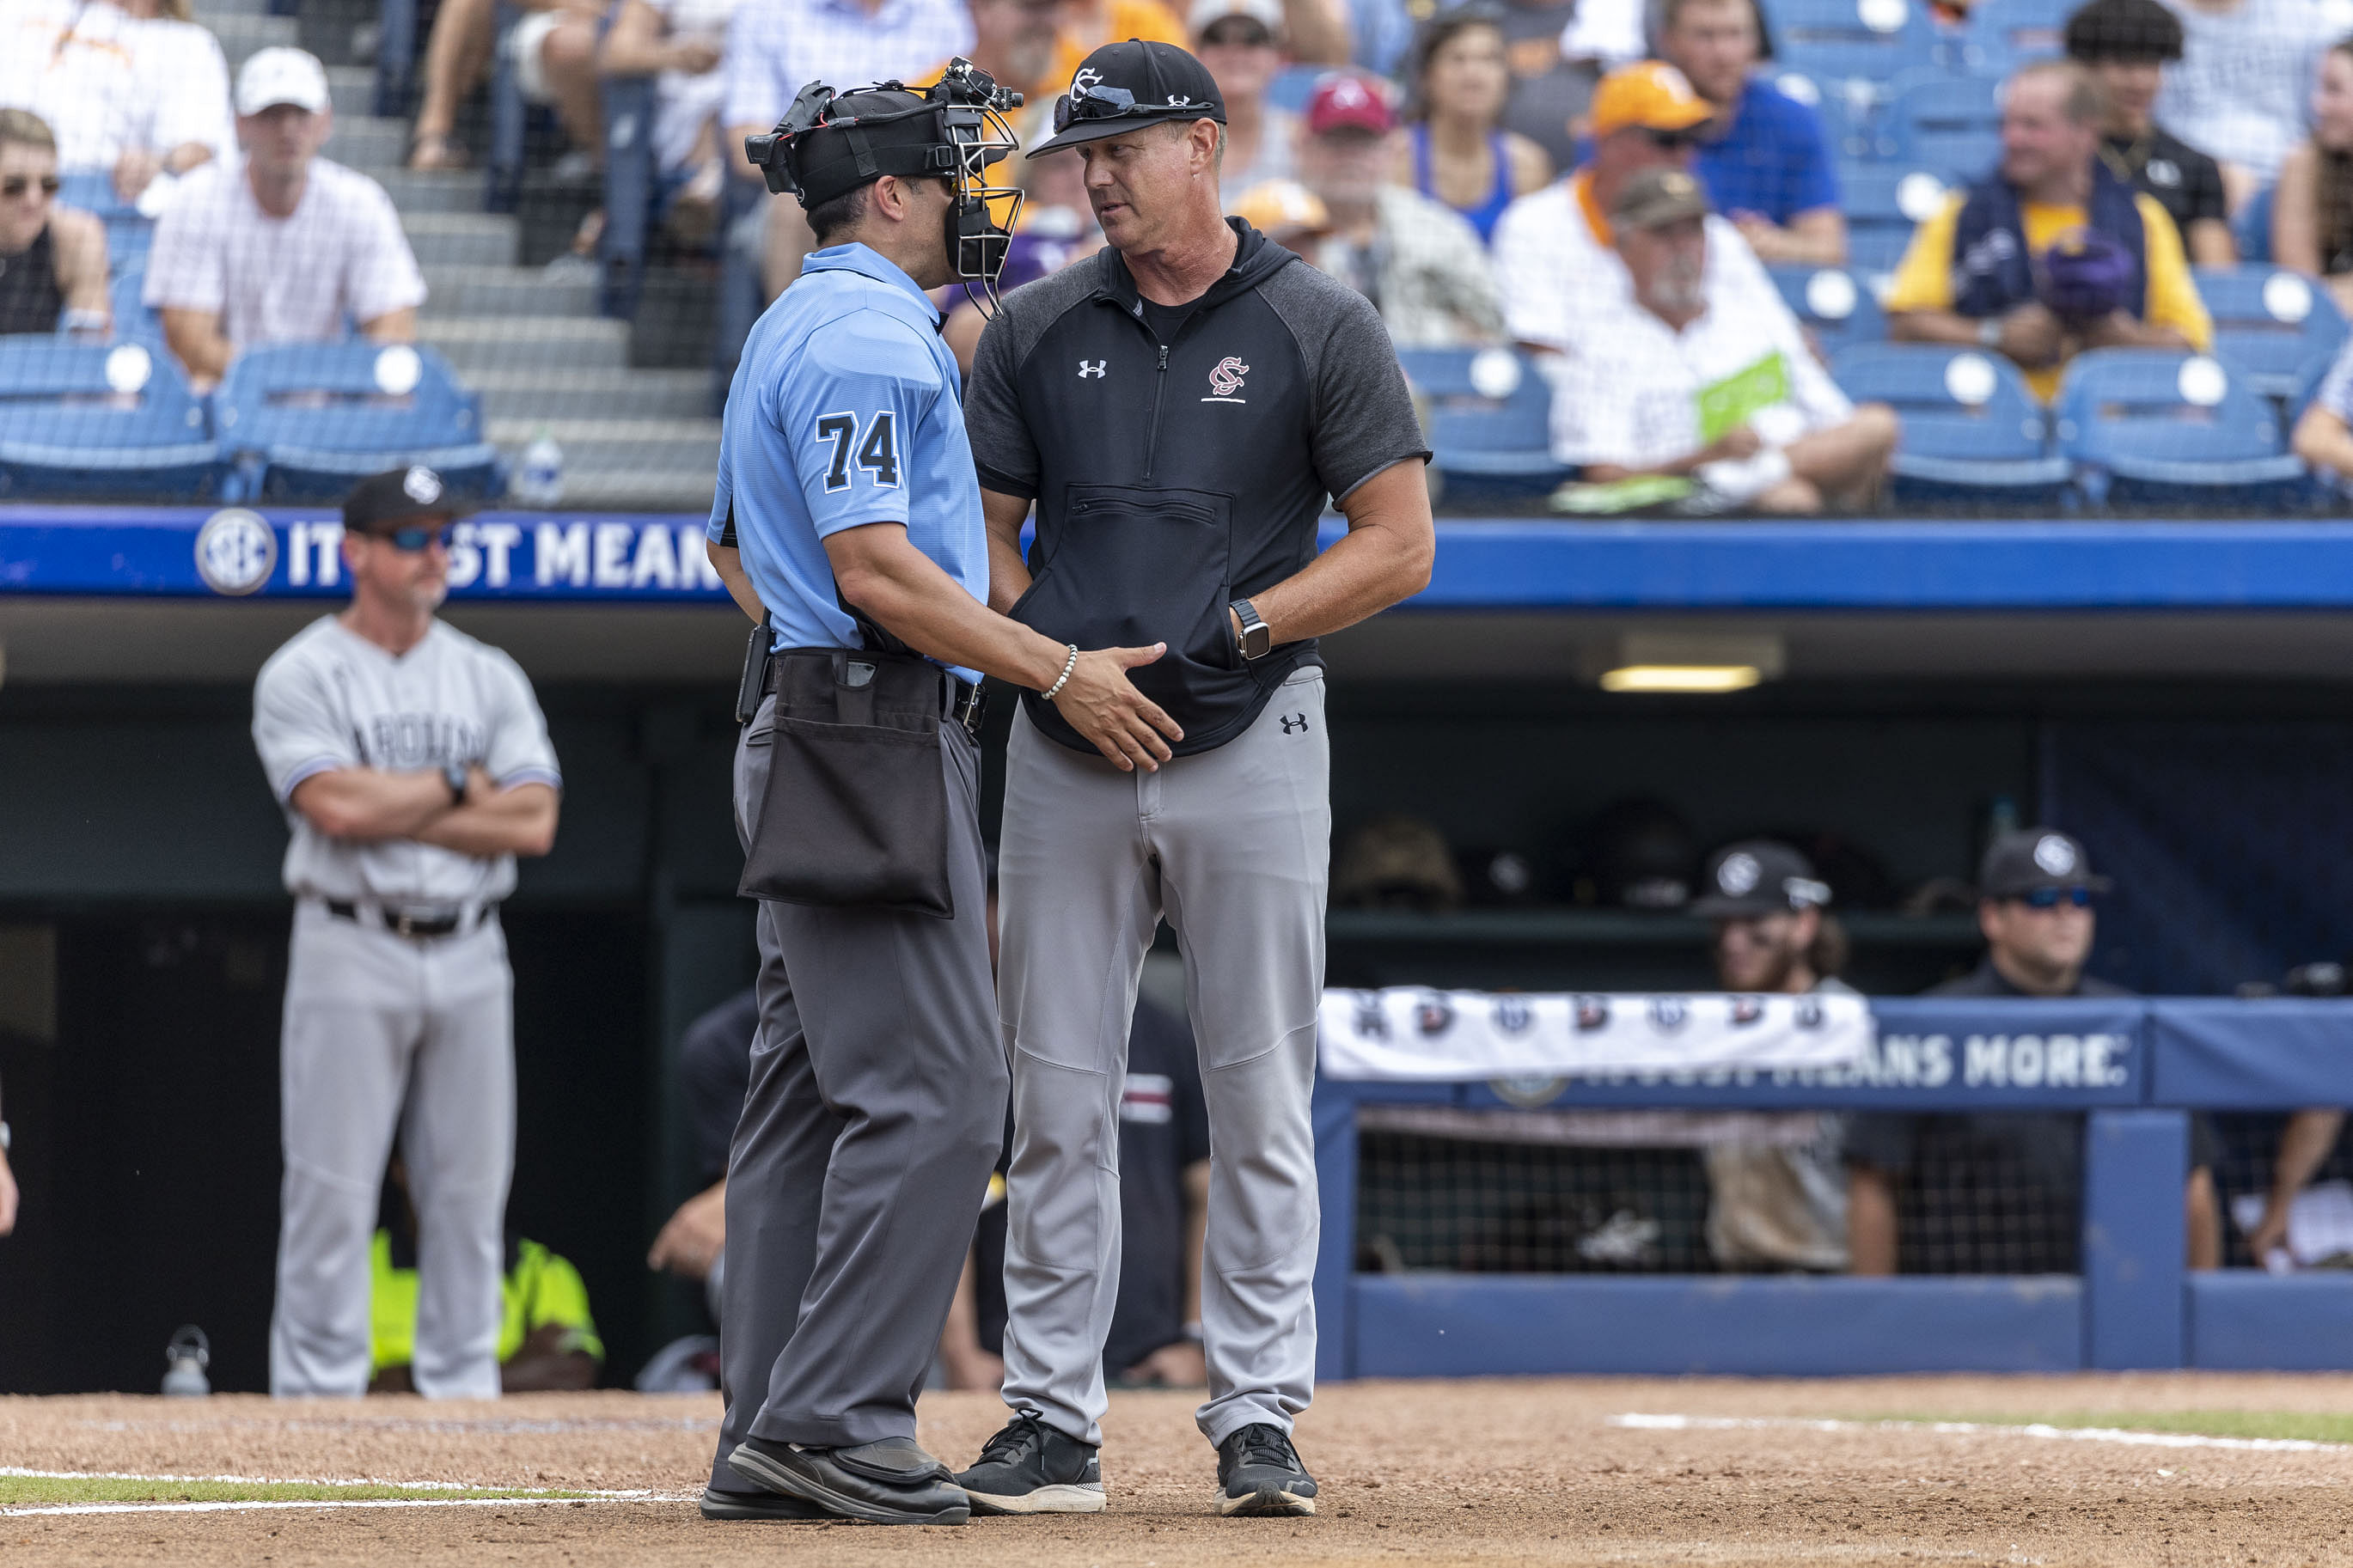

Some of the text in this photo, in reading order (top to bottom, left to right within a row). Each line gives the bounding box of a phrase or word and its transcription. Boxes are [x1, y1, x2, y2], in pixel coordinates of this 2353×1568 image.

[1208, 357, 1250, 395] SC
[815, 410, 901, 495] 74
[446, 522, 523, 589] ST
[534, 522, 723, 590] MEAN
